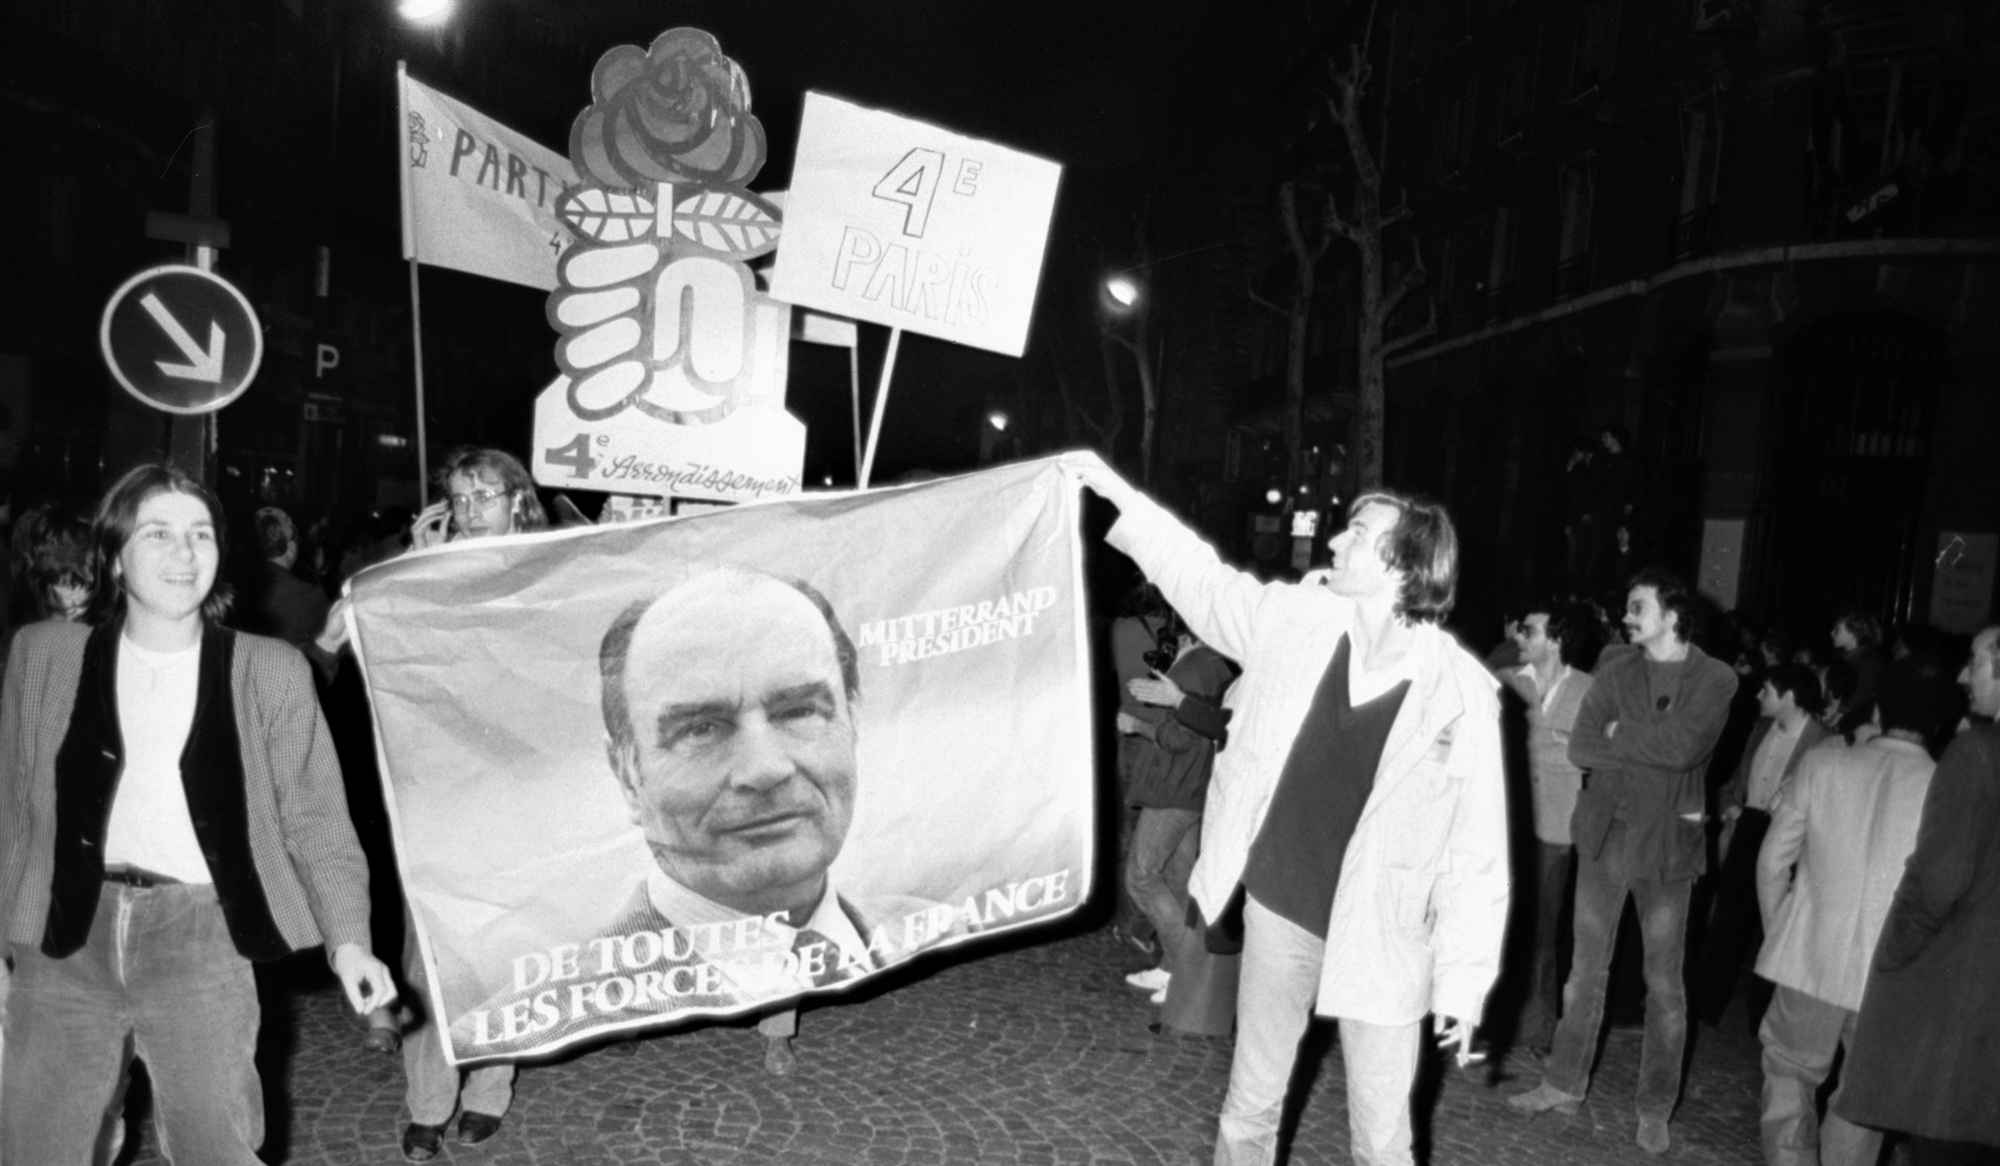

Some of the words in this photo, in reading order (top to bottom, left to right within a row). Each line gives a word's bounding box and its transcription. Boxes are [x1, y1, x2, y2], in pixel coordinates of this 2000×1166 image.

[450, 127, 568, 208] PART
[316, 343, 340, 378] P
[602, 455, 800, 497] Arrondissement
[858, 585, 1057, 647] MITTERRAND
[879, 611, 1039, 667] PRESIDENT
[511, 943, 580, 993] DE
[589, 910, 790, 974] TOUTES
[473, 990, 559, 1045] LES
[763, 941, 827, 983] DE
